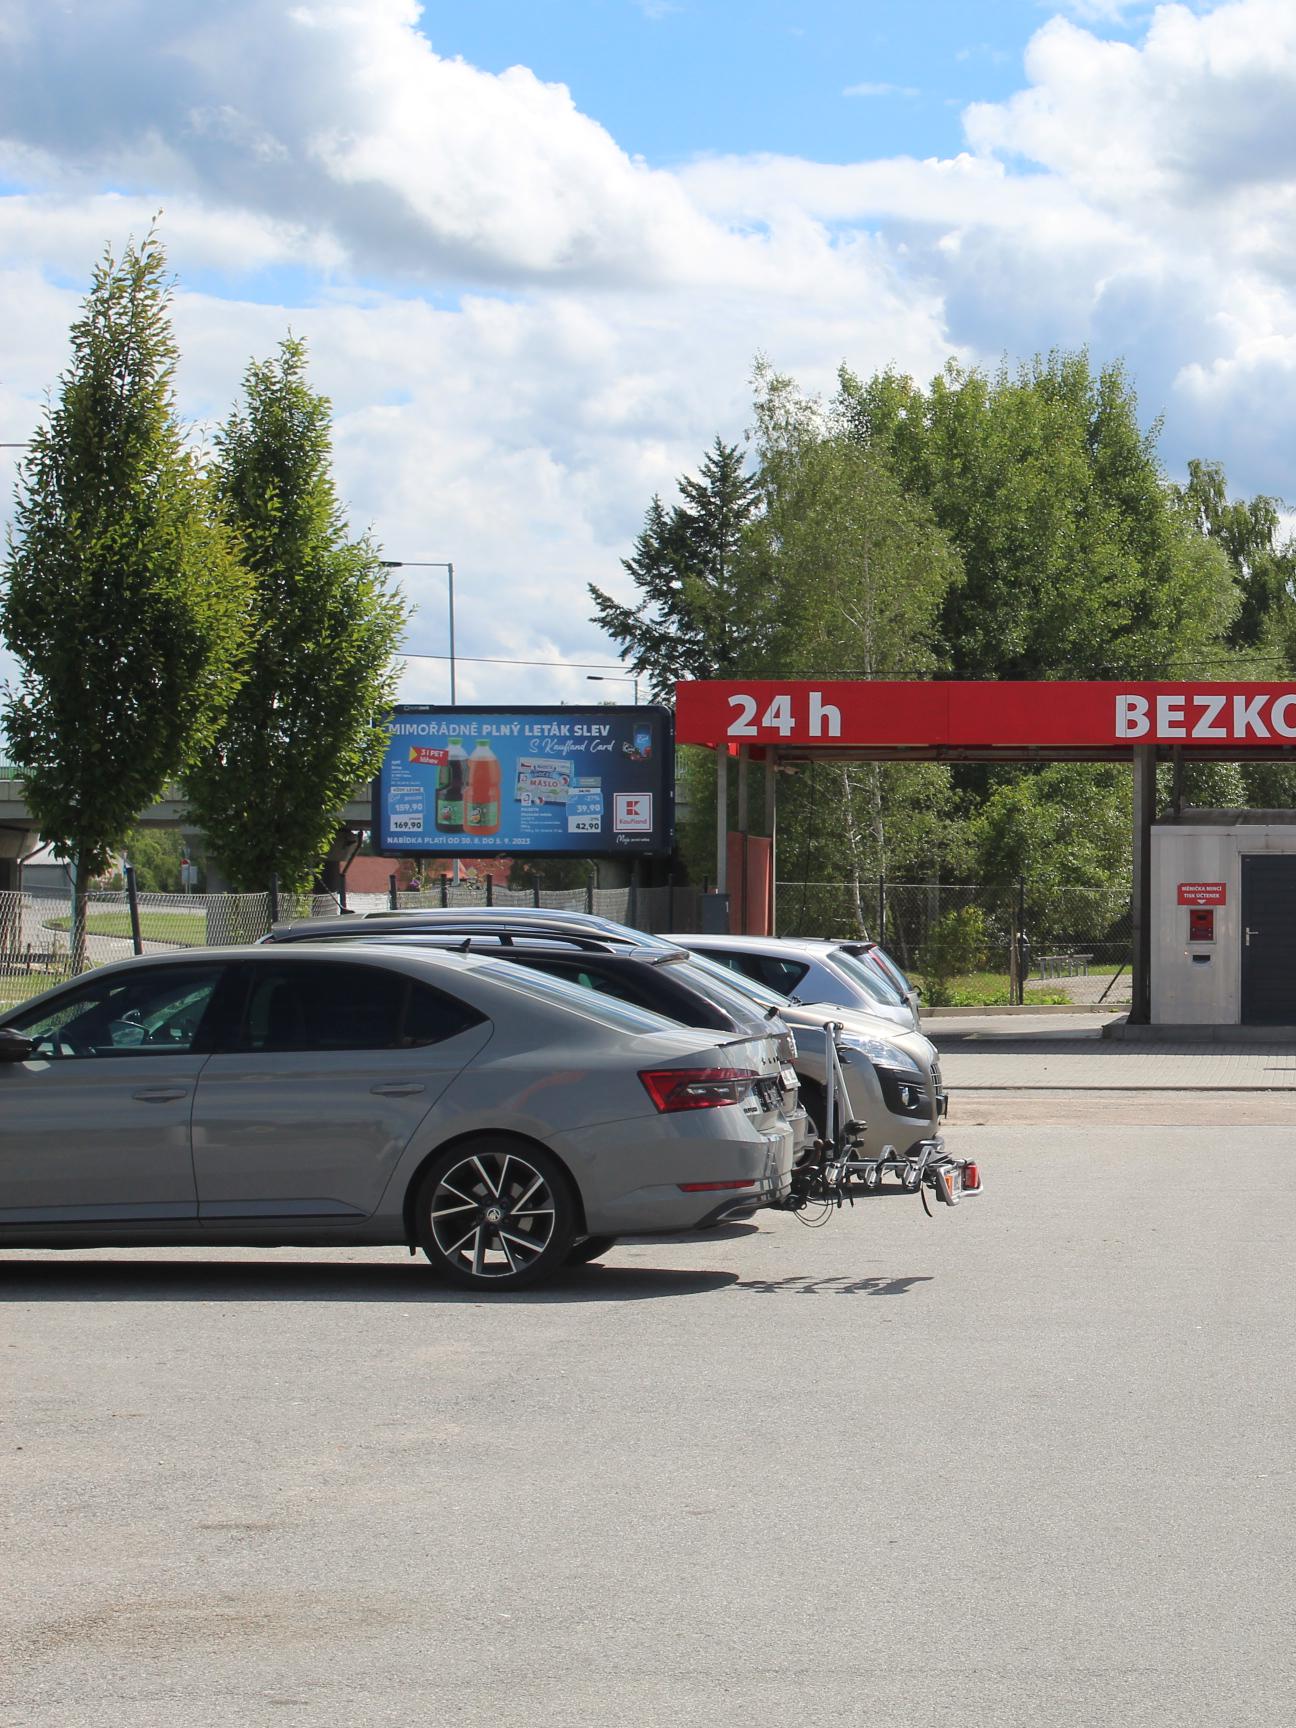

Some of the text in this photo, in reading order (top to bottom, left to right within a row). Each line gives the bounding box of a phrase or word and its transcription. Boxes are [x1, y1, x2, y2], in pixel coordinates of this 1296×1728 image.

[727, 691, 842, 737] 24 h
[482, 721, 520, 736] PLNÝ
[525, 721, 571, 737] LETÁK
[573, 724, 611, 737] SLEV
[542, 738, 587, 756] Kaufland
[589, 739, 615, 753] Card
[394, 821, 422, 830] 169,90
[575, 822, 600, 831] 42,90
[387, 836, 422, 844] NABÍDKA
[424, 836, 446, 844] PLATÍ
